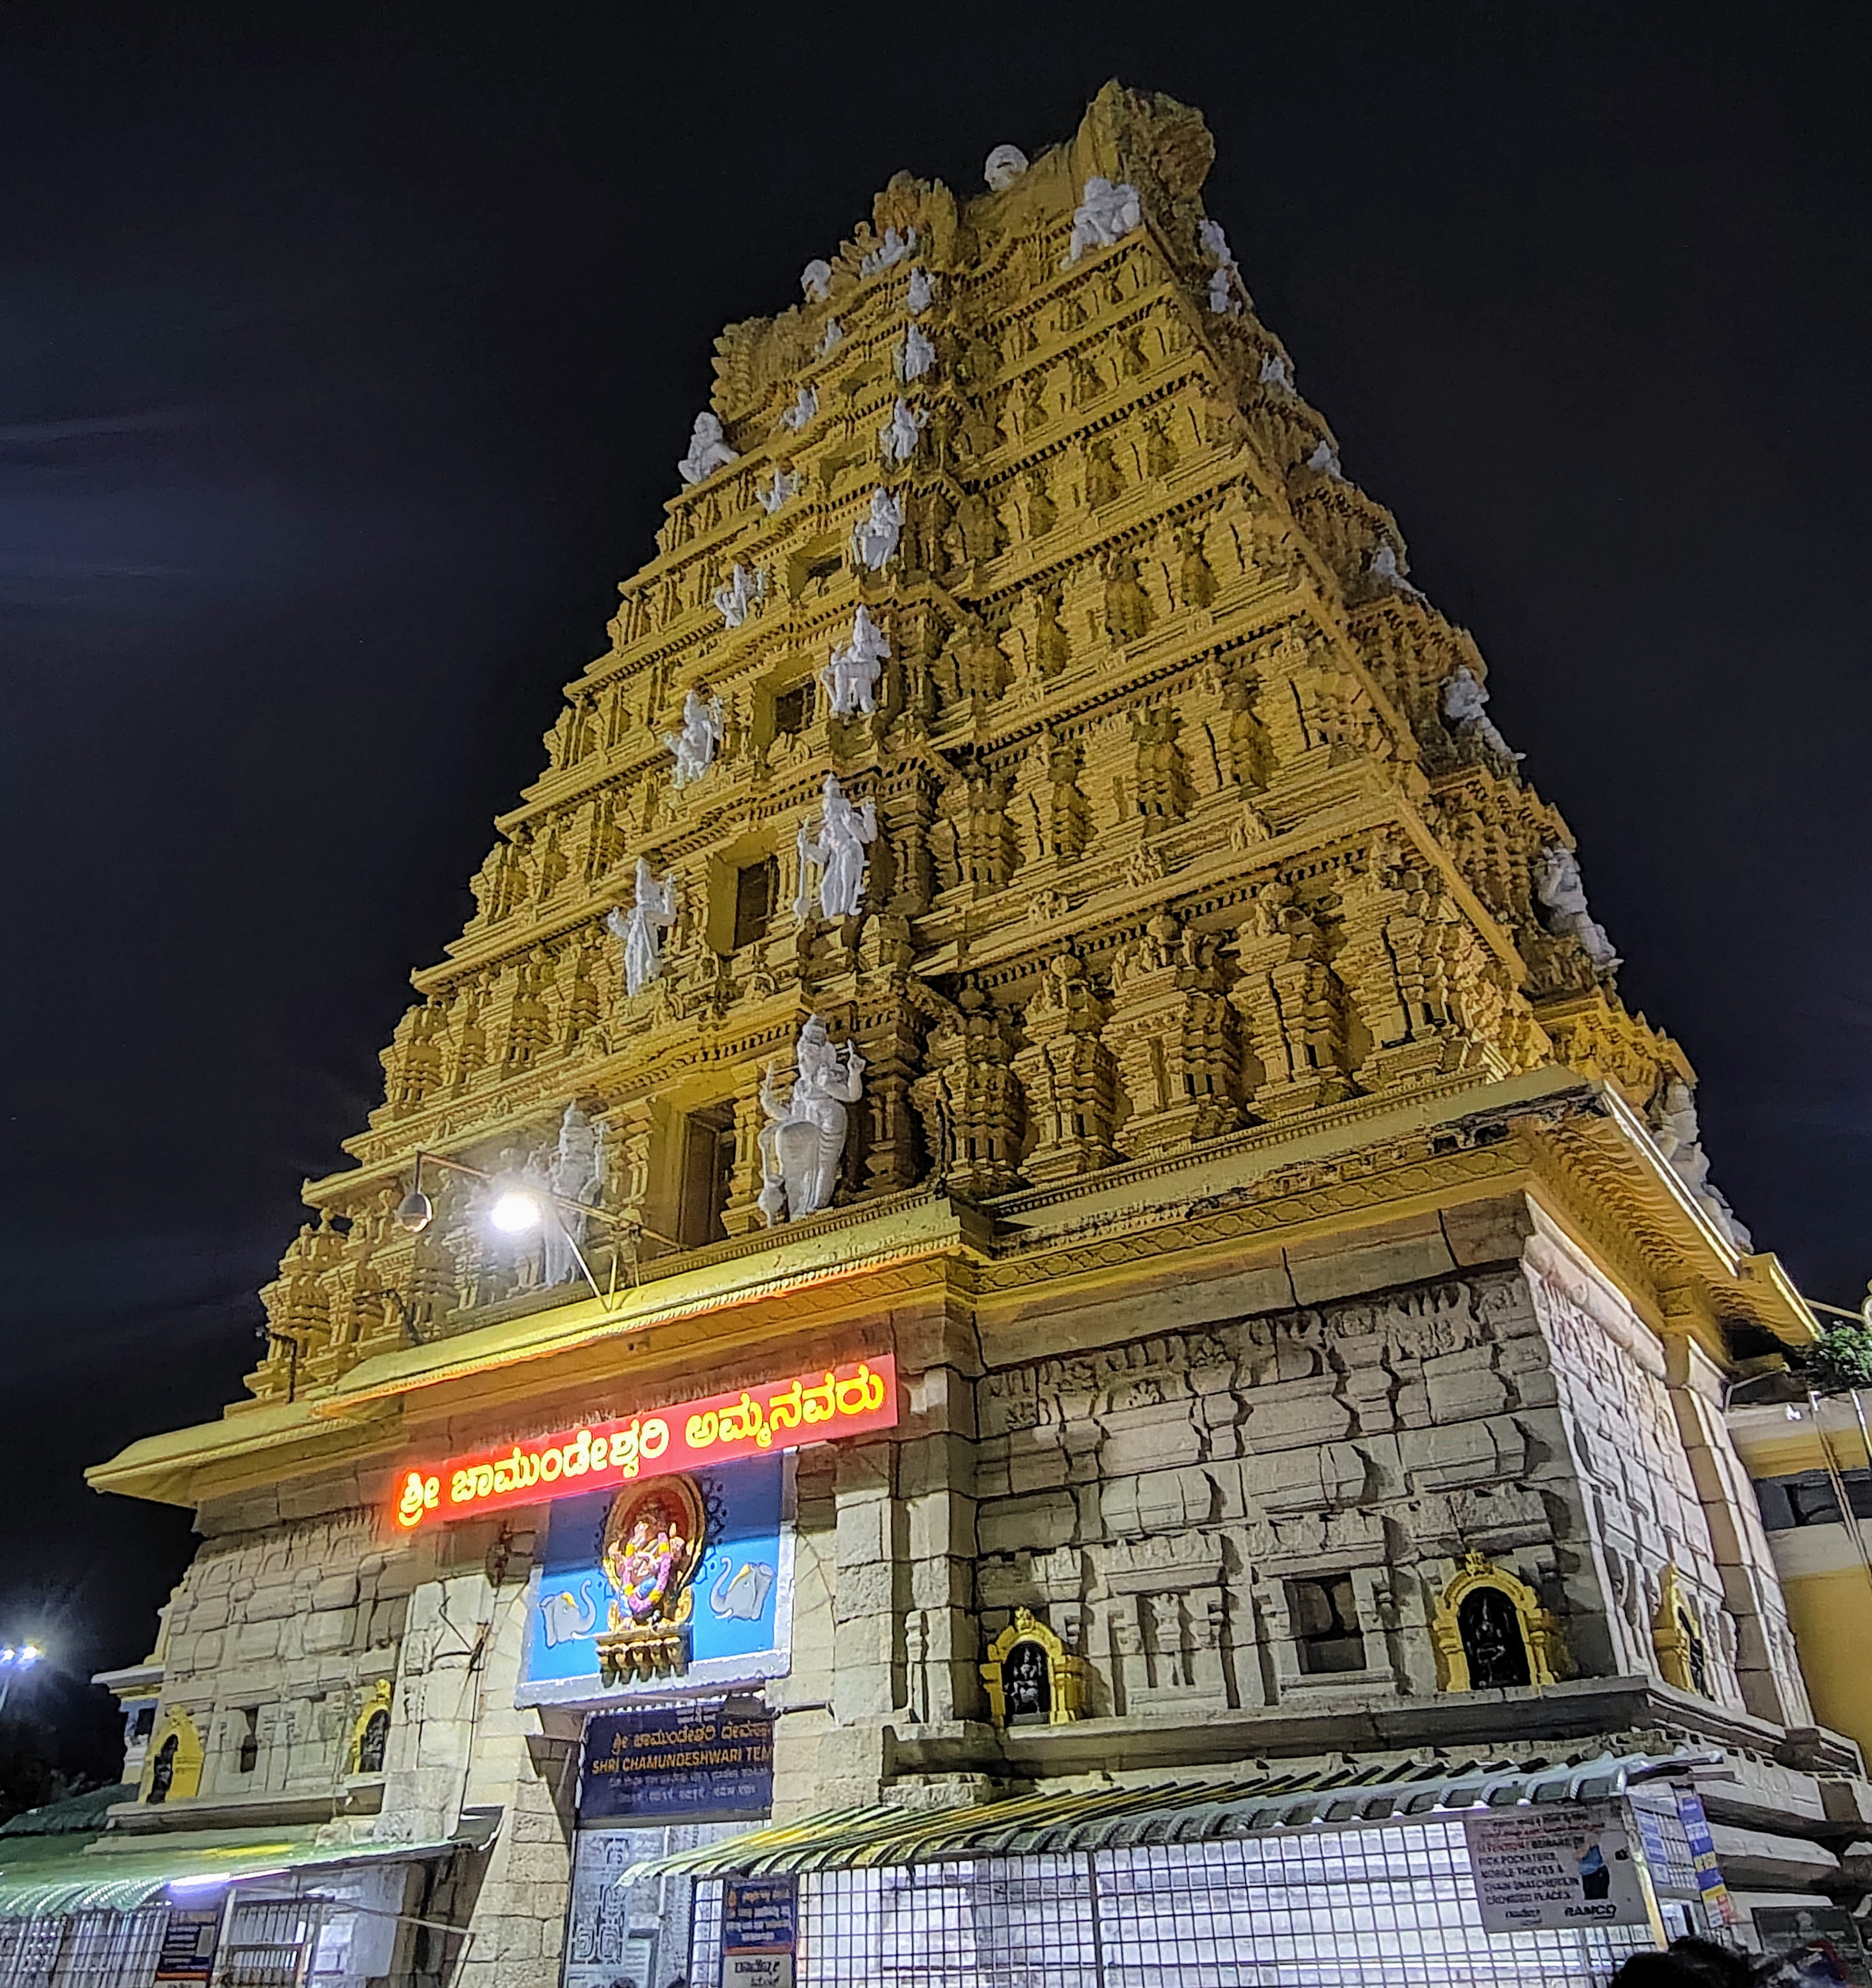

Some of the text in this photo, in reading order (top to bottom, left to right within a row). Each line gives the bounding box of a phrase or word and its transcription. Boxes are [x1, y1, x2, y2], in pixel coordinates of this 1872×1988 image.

[398, 1364, 884, 1528] ಶ್ರೀ ಚಾಮುಂಡೇಶ್ವರಿ ಅಮ್ಮನವರು
[592, 1757, 619, 1775] SHRI
[622, 1748, 742, 1772] CHAMUNDESHWARI
